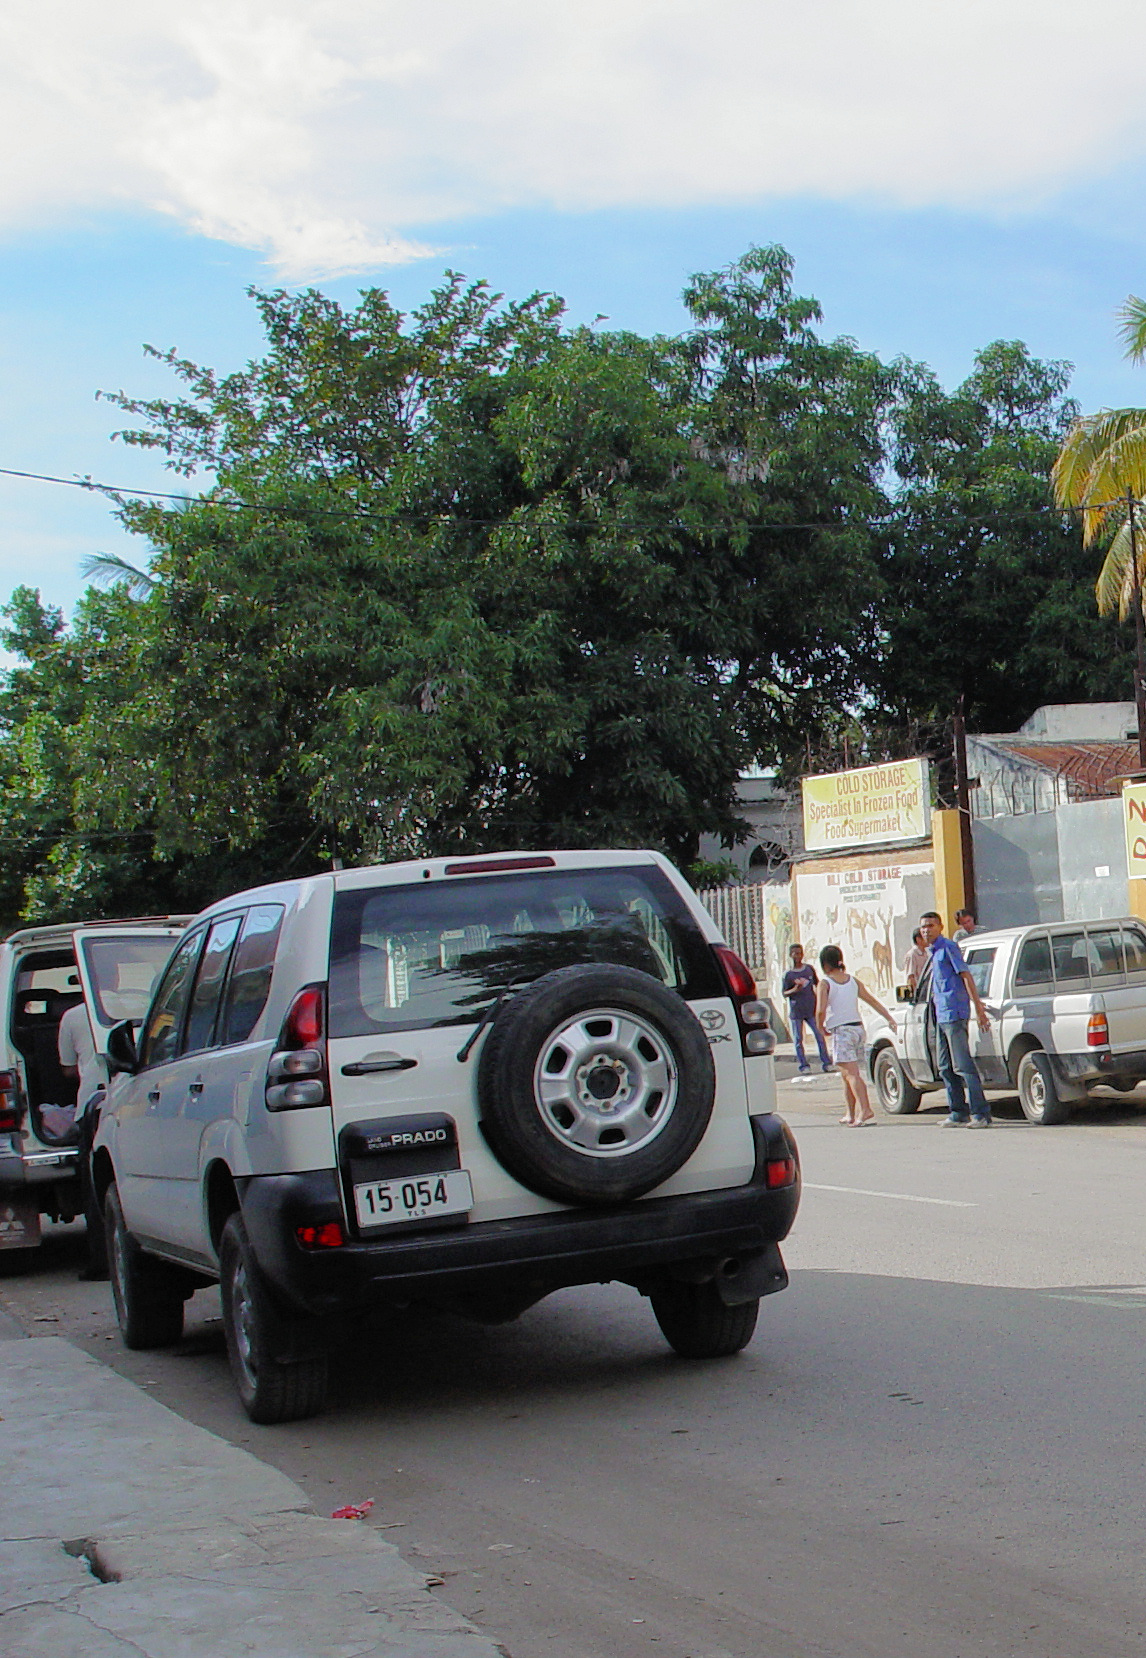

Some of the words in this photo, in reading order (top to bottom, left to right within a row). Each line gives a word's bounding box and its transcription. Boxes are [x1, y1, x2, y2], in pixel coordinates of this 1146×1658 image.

[836, 775, 860, 796] COLD
[862, 767, 907, 792] STORAGE
[809, 799, 851, 823] Specialist
[853, 797, 862, 814] In
[863, 795, 894, 813] Frozen
[896, 788, 918, 809] Food
[825, 821, 847, 839] Food
[391, 1129, 447, 1146] PRADO
[407, 1208, 427, 1218] TLS
